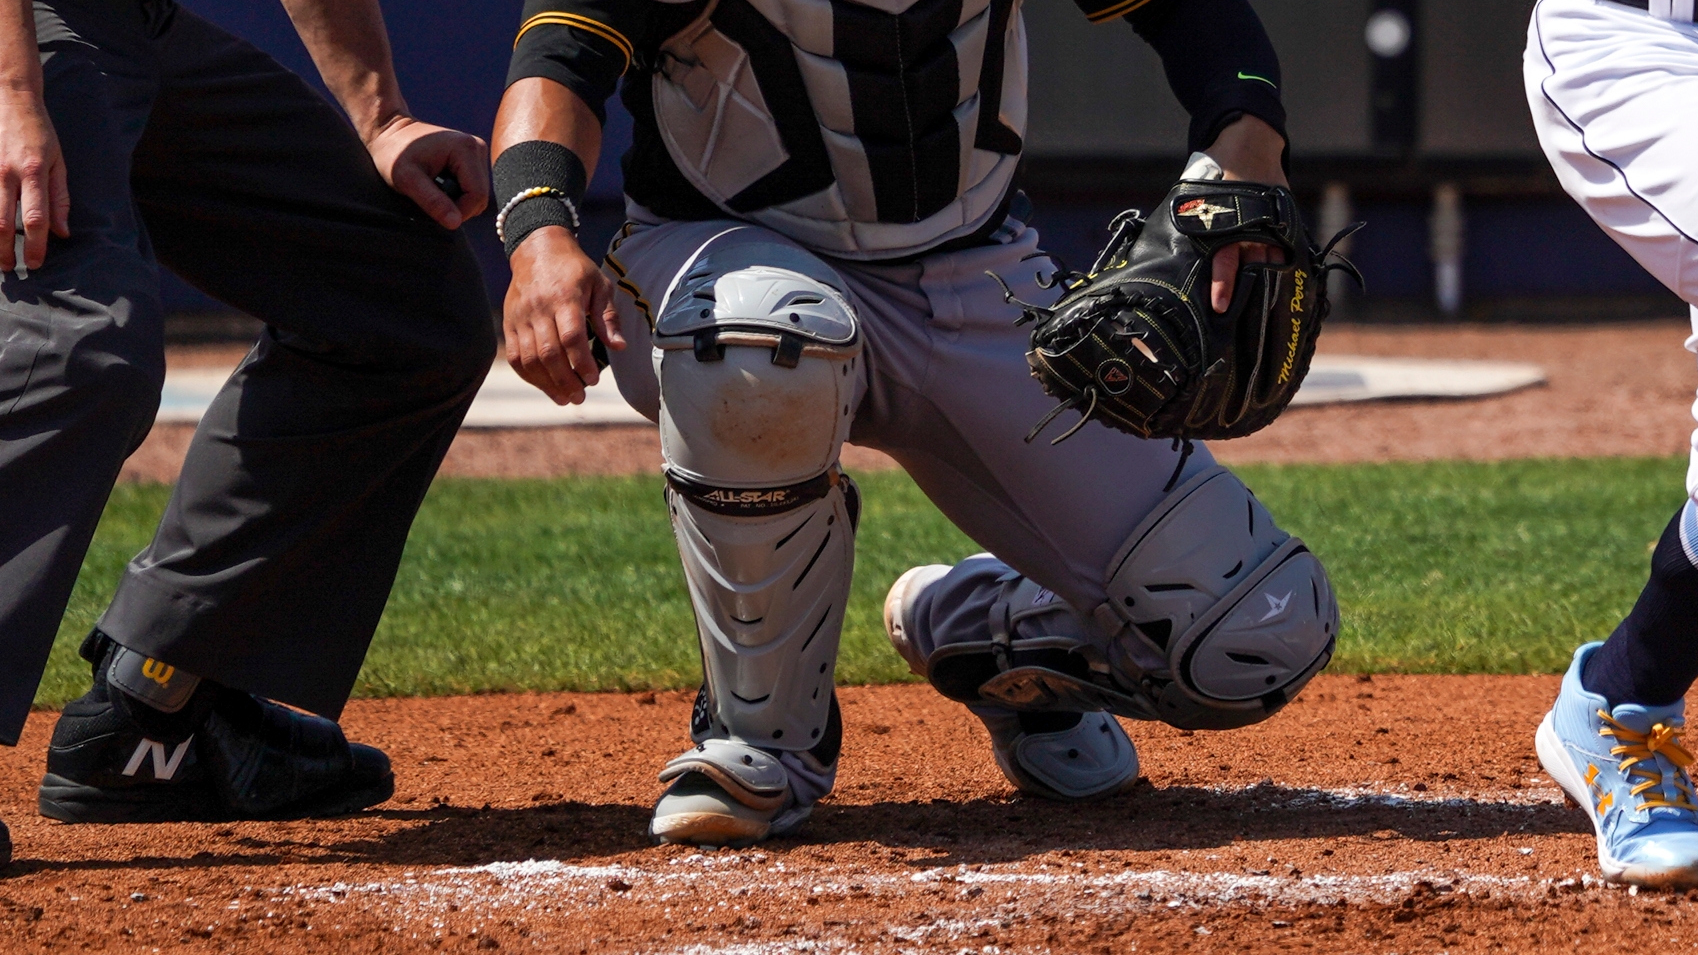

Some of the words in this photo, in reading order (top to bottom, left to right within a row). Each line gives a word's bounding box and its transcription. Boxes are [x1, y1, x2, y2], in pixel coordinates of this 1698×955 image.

[1278, 318, 1302, 385] Michael
[1291, 268, 1308, 313] Perez
[703, 489, 788, 504] ALL-STAR
